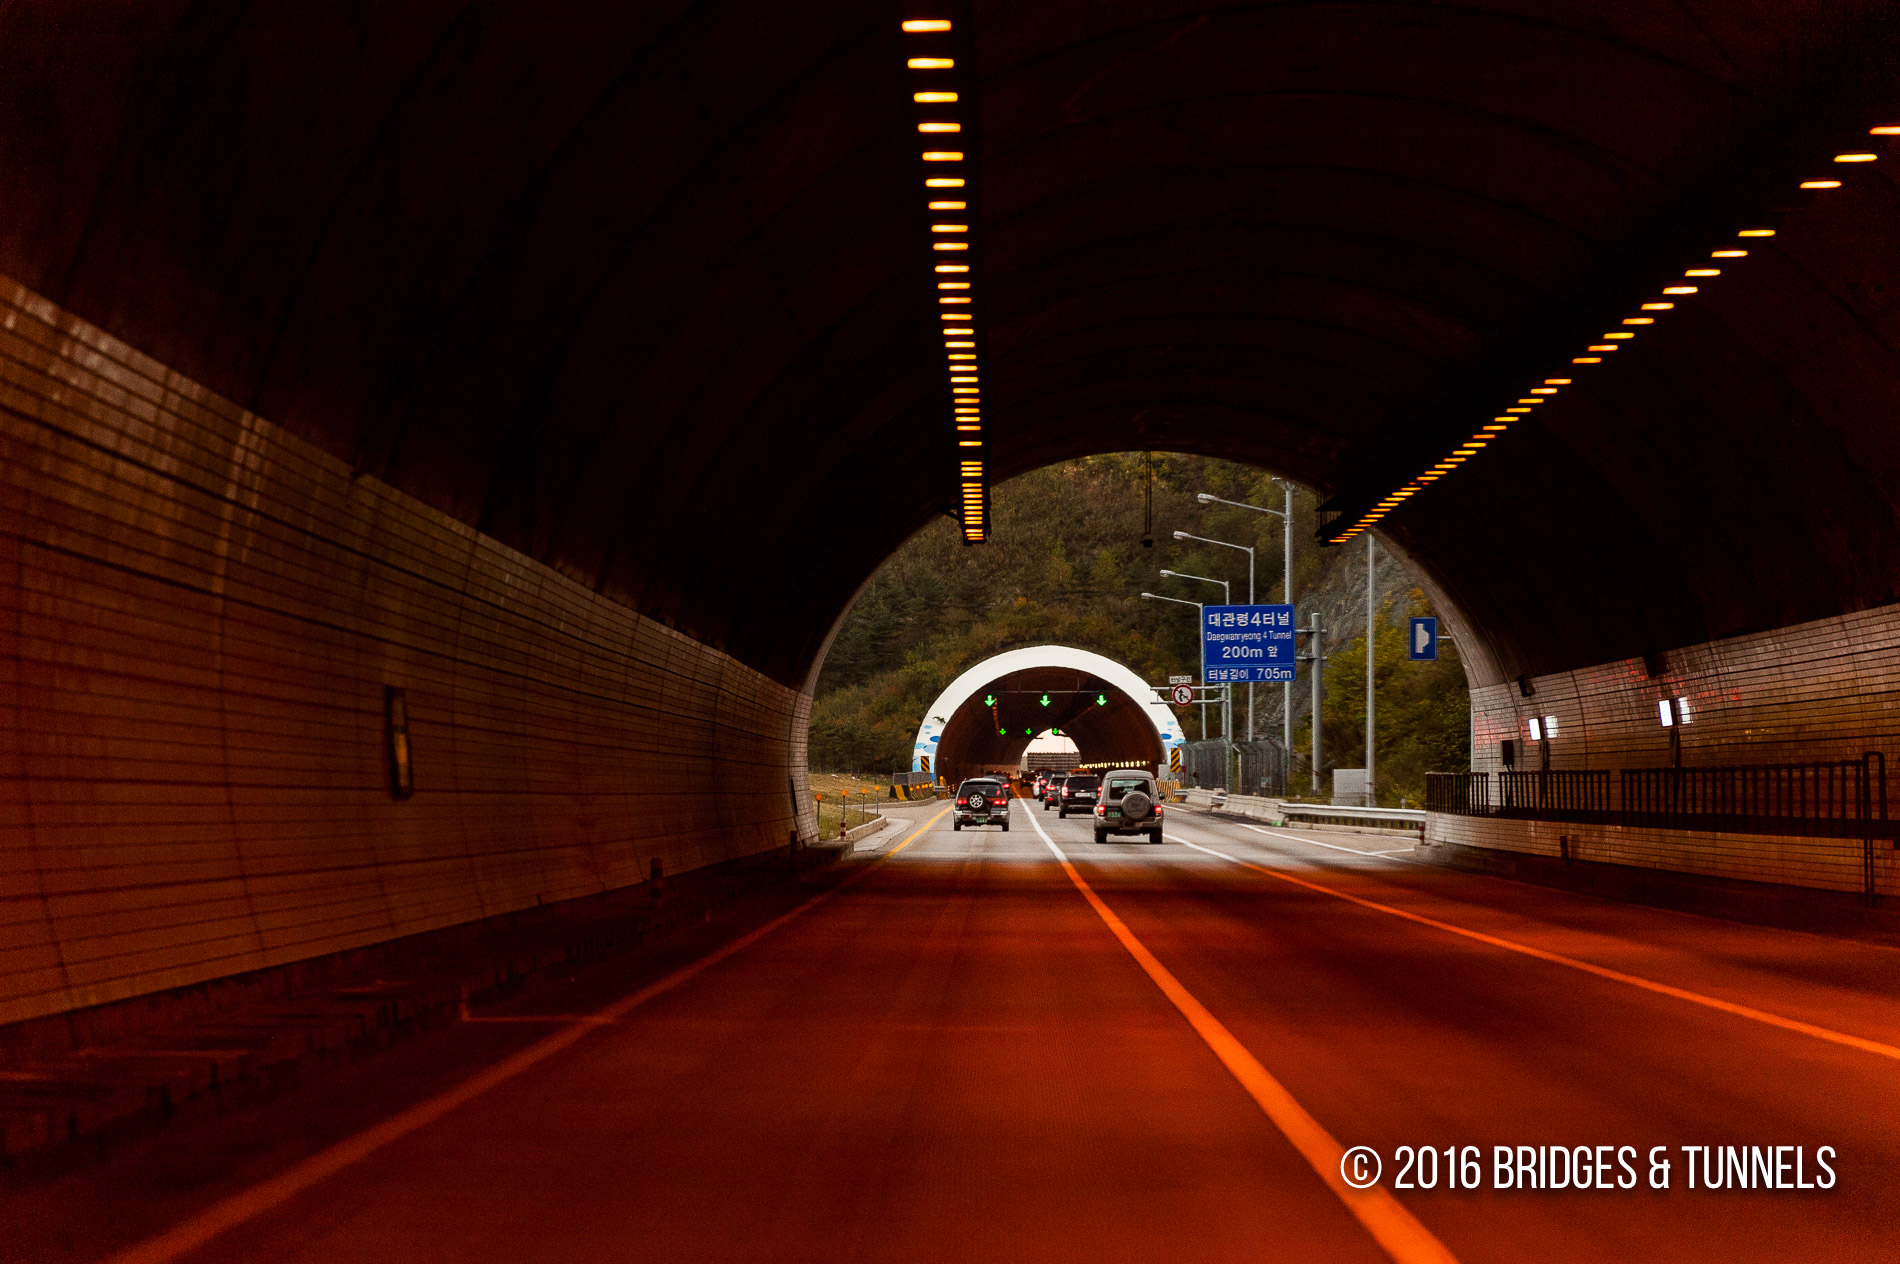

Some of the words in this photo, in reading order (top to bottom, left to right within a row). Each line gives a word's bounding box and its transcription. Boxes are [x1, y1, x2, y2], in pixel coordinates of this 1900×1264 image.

[1208, 611, 1290, 627] 대관령4터널
[1207, 631, 1262, 643] Daegwanryeong
[1262, 631, 1268, 639] 4
[1268, 630, 1292, 640] Tunnel
[1222, 646, 1264, 658] 200m
[1267, 645, 1279, 658] 앞
[1208, 668, 1249, 680] 터널길이
[1256, 667, 1292, 679] 705m
